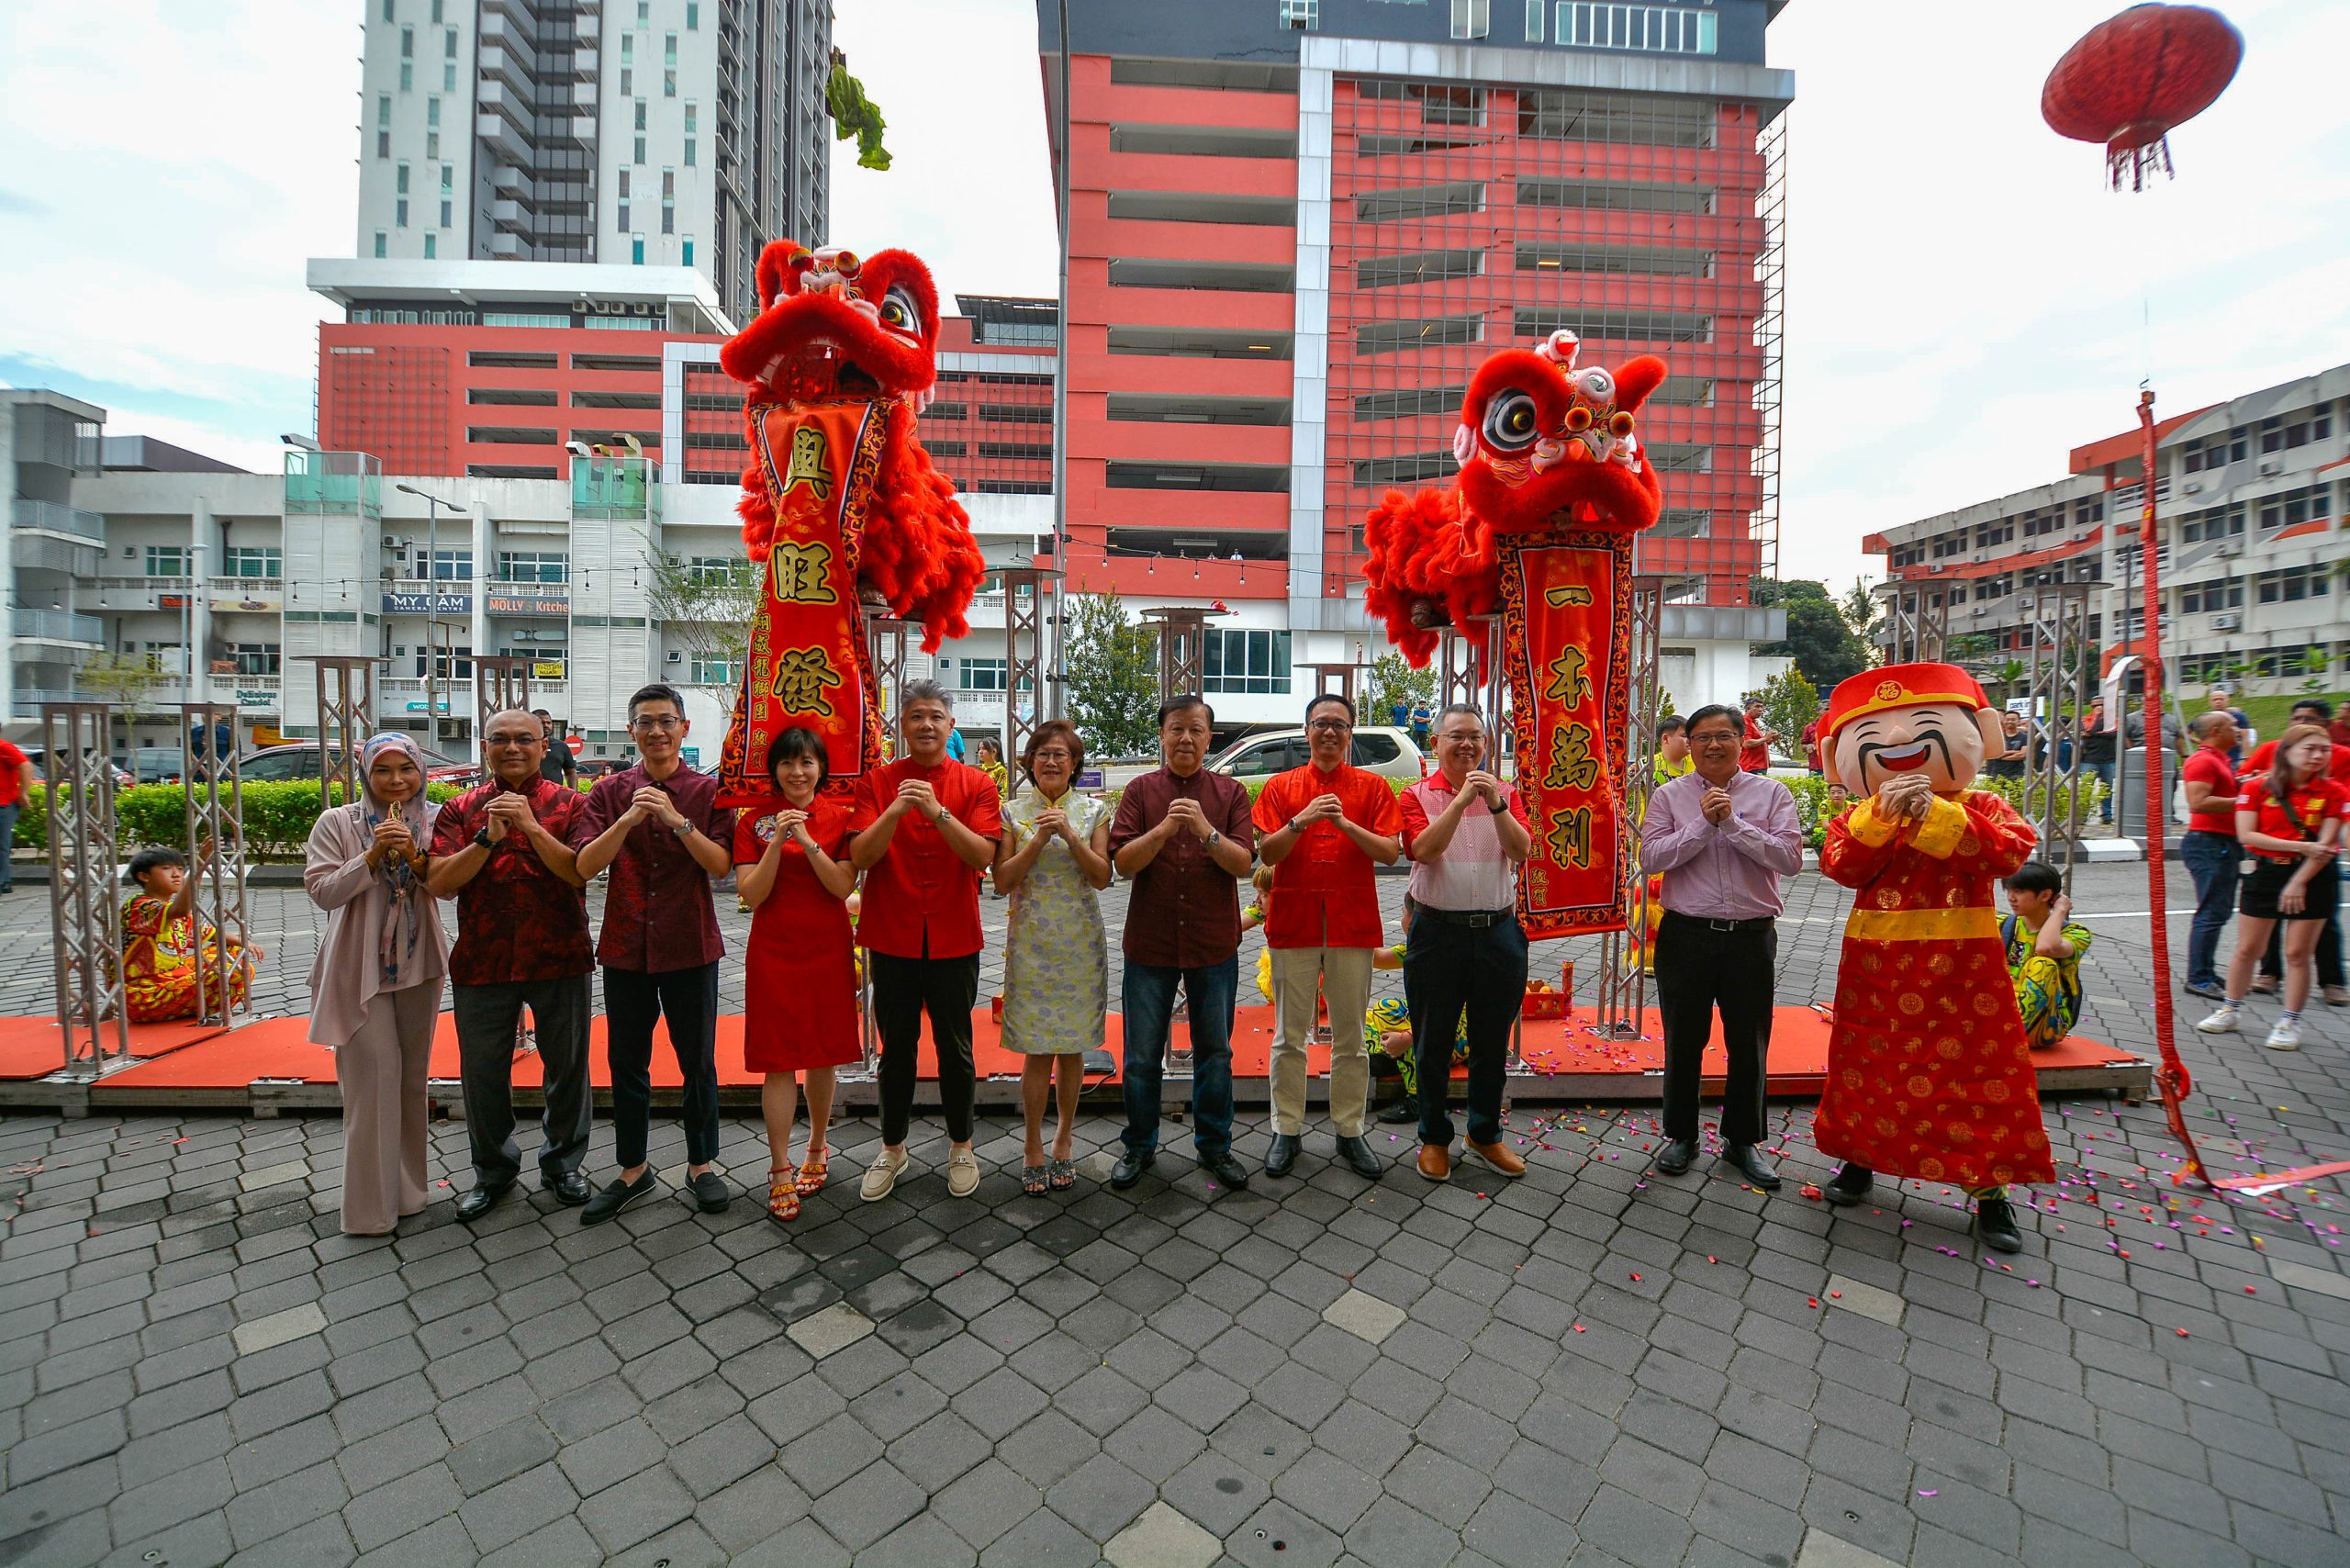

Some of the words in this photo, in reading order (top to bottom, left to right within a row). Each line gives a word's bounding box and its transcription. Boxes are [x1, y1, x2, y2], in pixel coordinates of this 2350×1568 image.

[394, 597, 419, 606] MY
[536, 600, 569, 612] Kitche
[1544, 587, 1598, 868] 一本萬利
